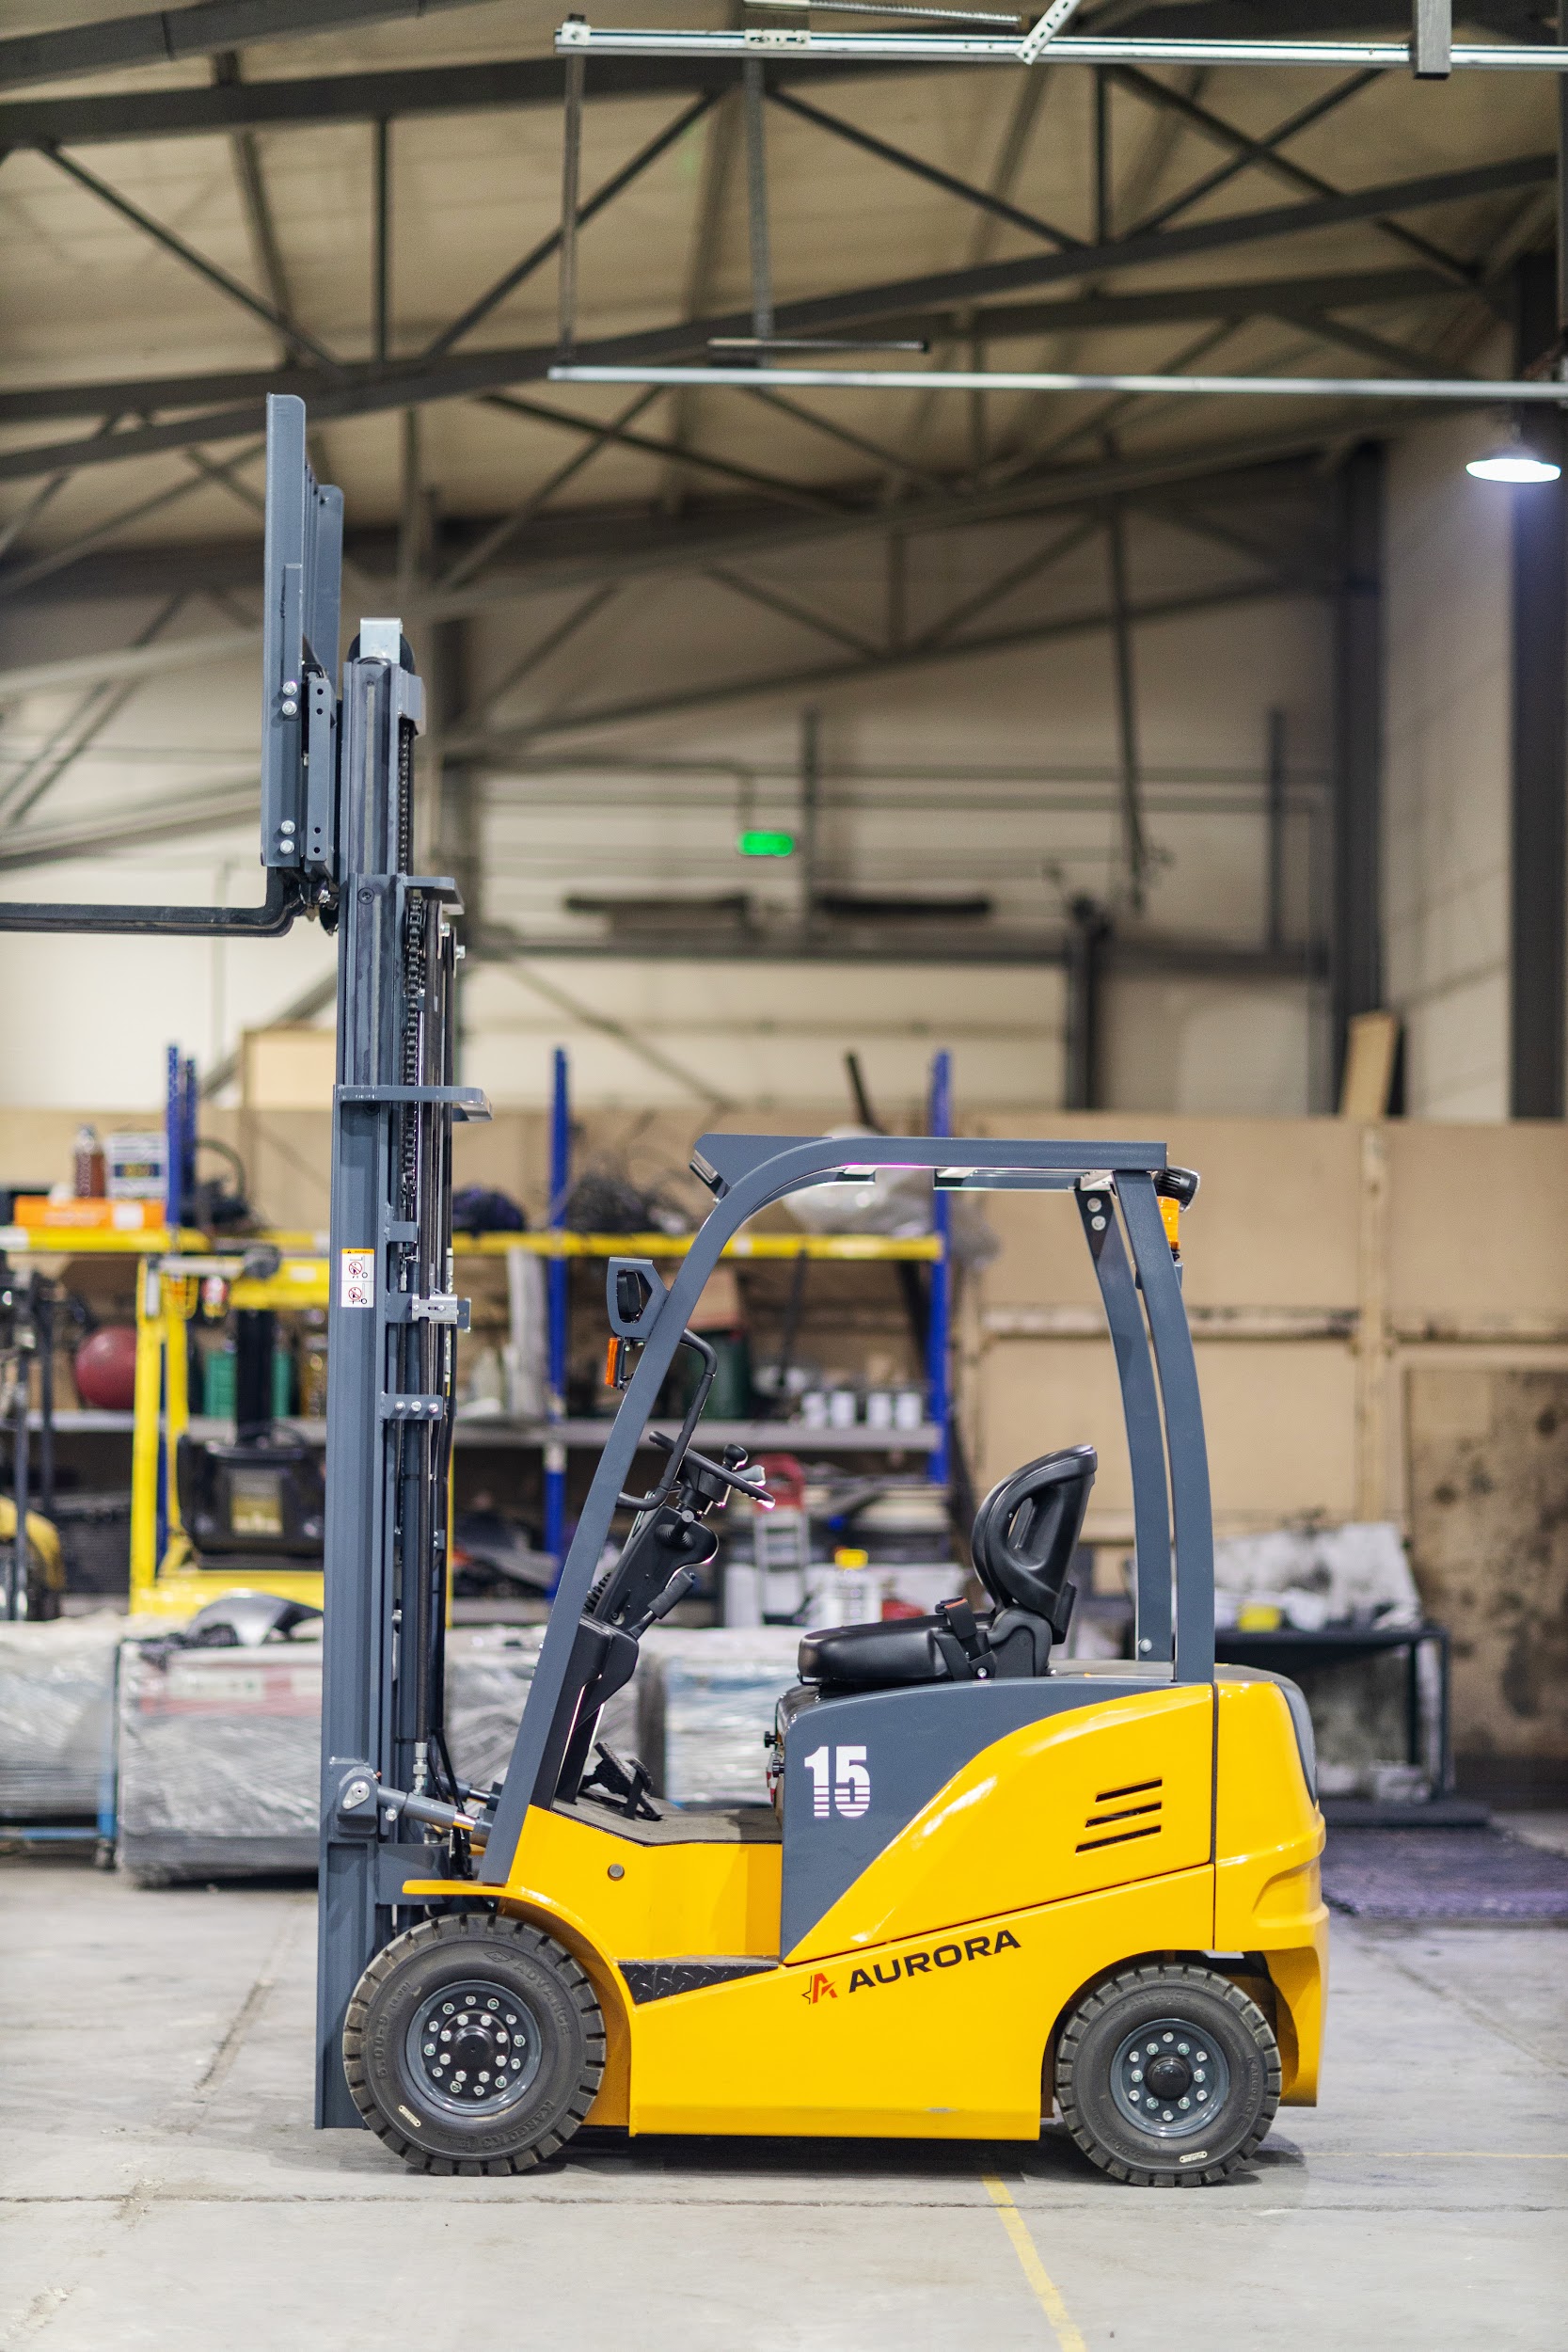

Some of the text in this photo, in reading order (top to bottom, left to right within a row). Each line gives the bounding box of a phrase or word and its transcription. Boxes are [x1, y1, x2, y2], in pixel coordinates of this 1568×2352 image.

[804, 1746, 870, 1818] 15
[848, 1930, 1022, 1994] AURORA
[513, 1961, 570, 2034] ADVANCE
[508, 2099, 556, 2141] KARGO
